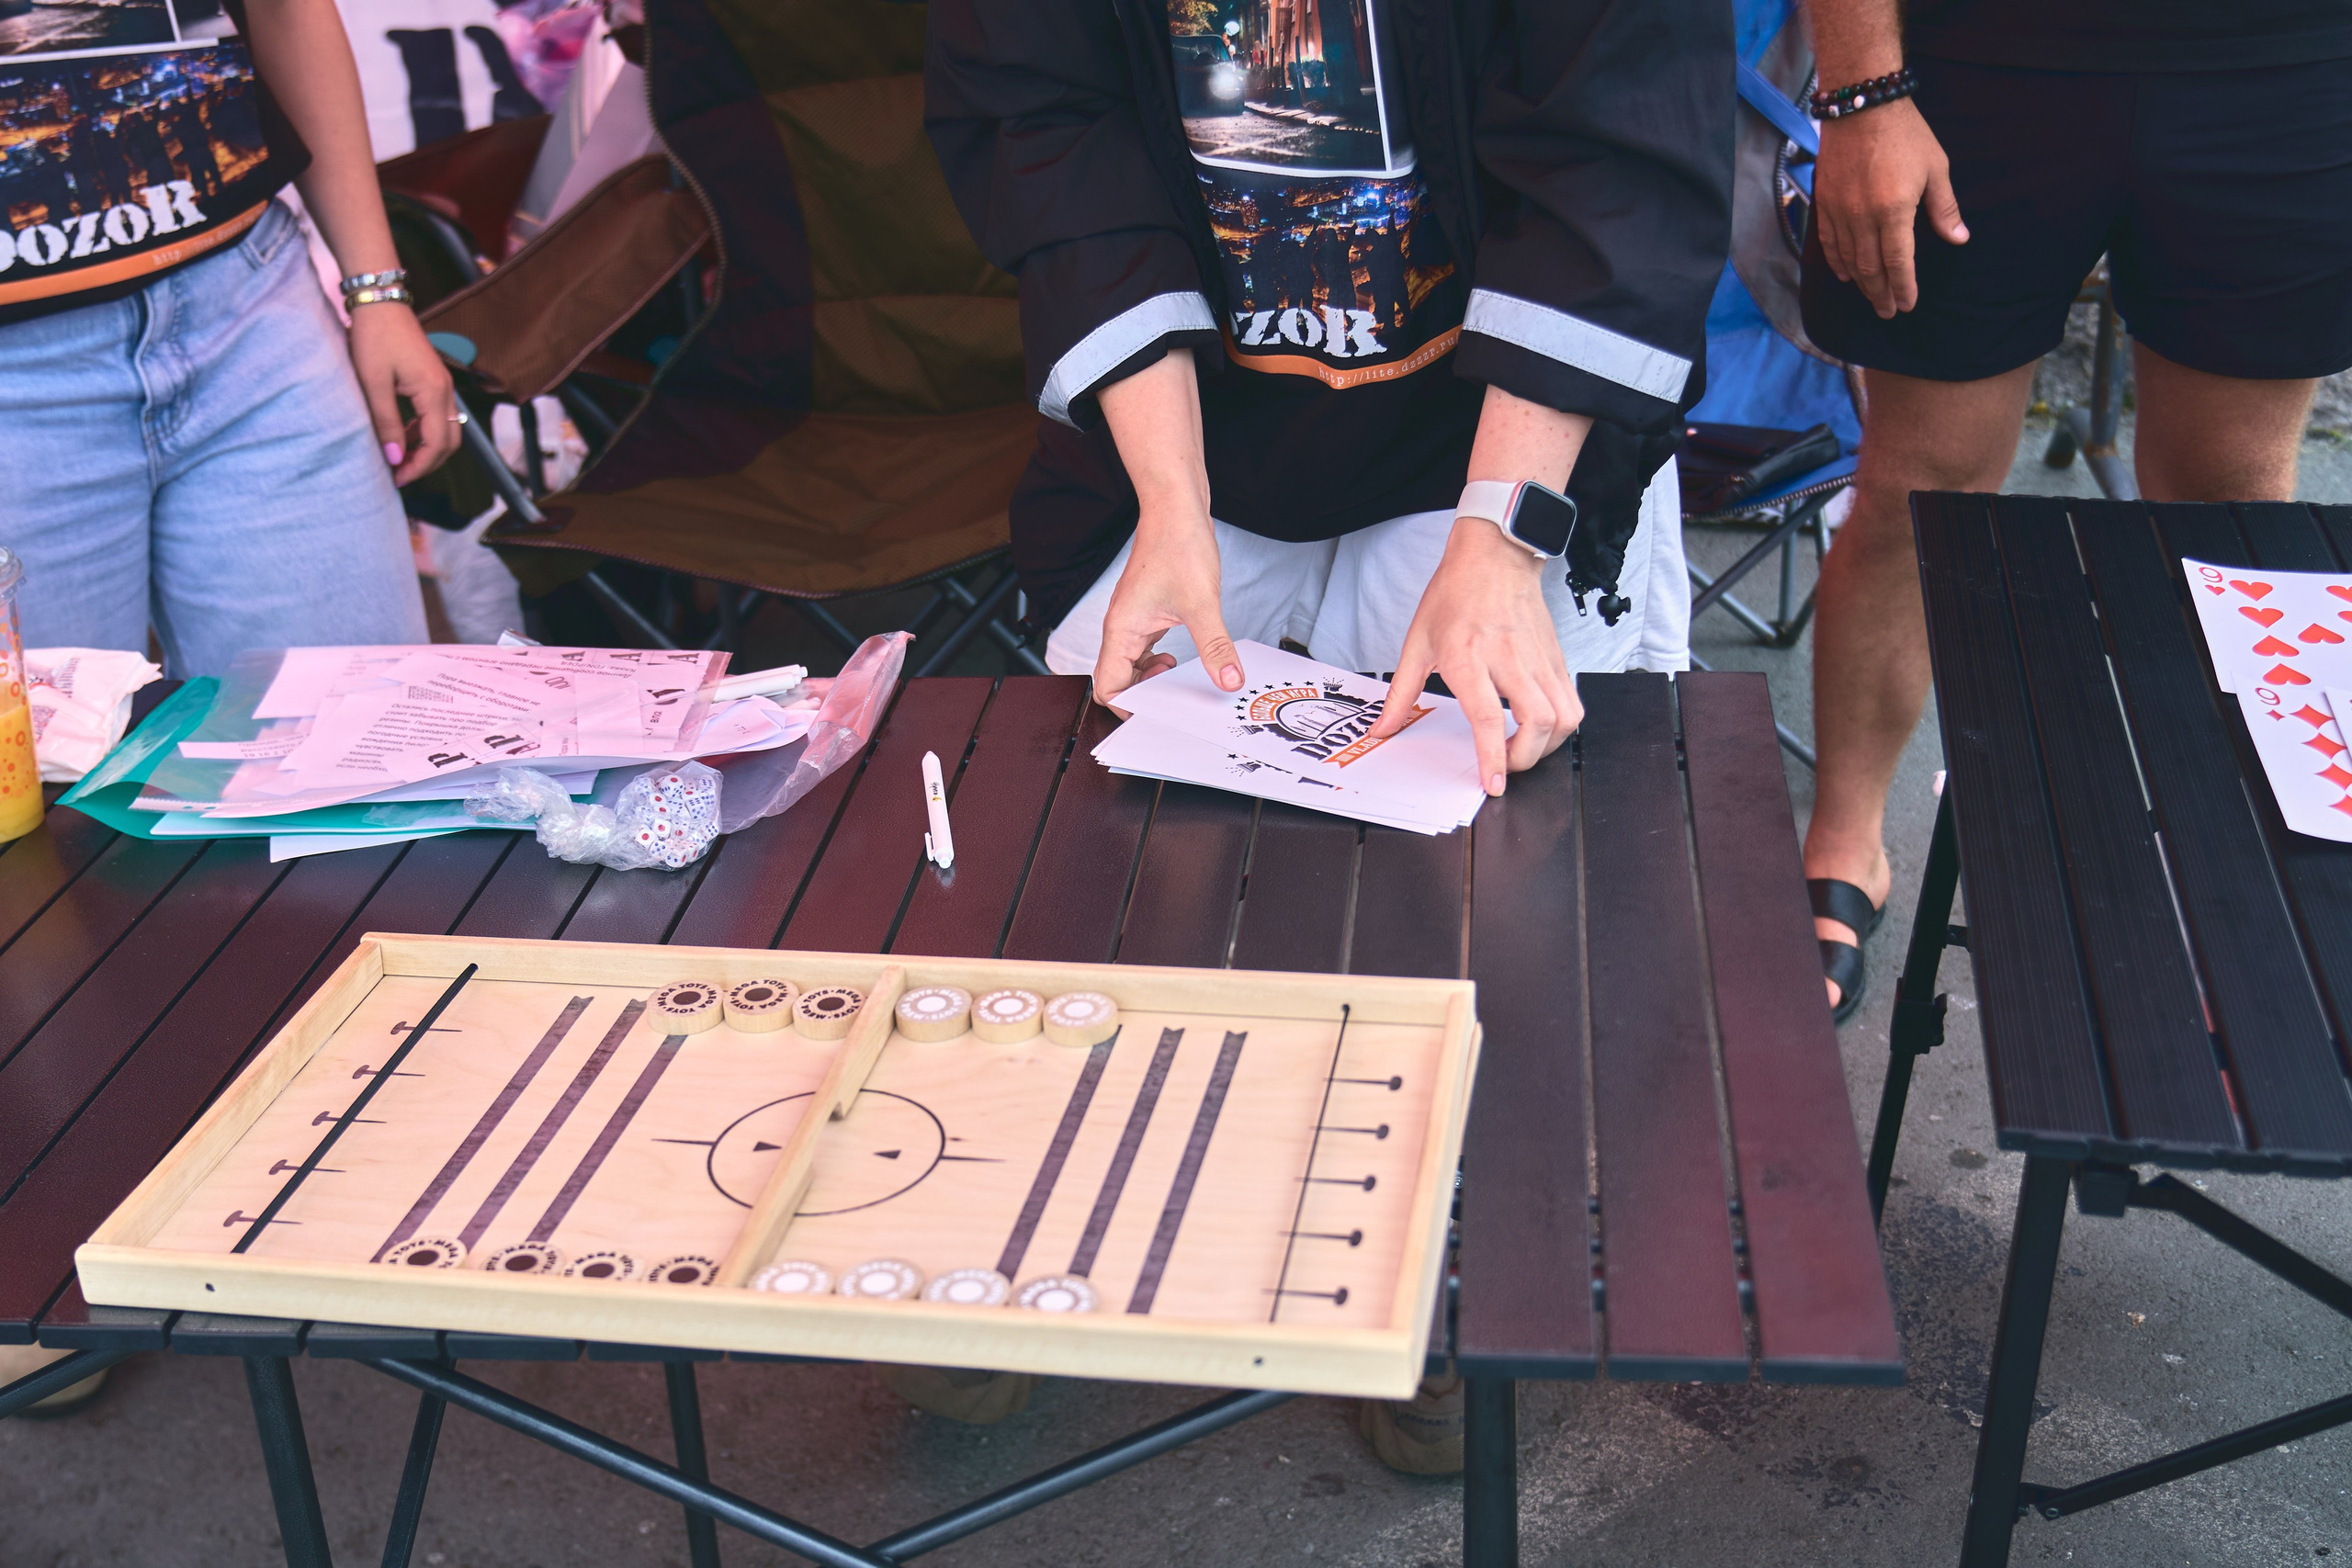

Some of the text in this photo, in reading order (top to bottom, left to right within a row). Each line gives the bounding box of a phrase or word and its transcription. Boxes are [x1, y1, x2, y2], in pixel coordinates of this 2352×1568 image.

[1229, 304, 1387, 358] ZOR
[437, 672, 458, 682] Пора
[1285, 688, 1317, 699] ИГРА
[391, 703, 429, 712] Остались
[430, 707, 475, 716] последние
[410, 713, 447, 721] забывать
[368, 730, 408, 739] погодные
[678, 982, 707, 990] TOYS
